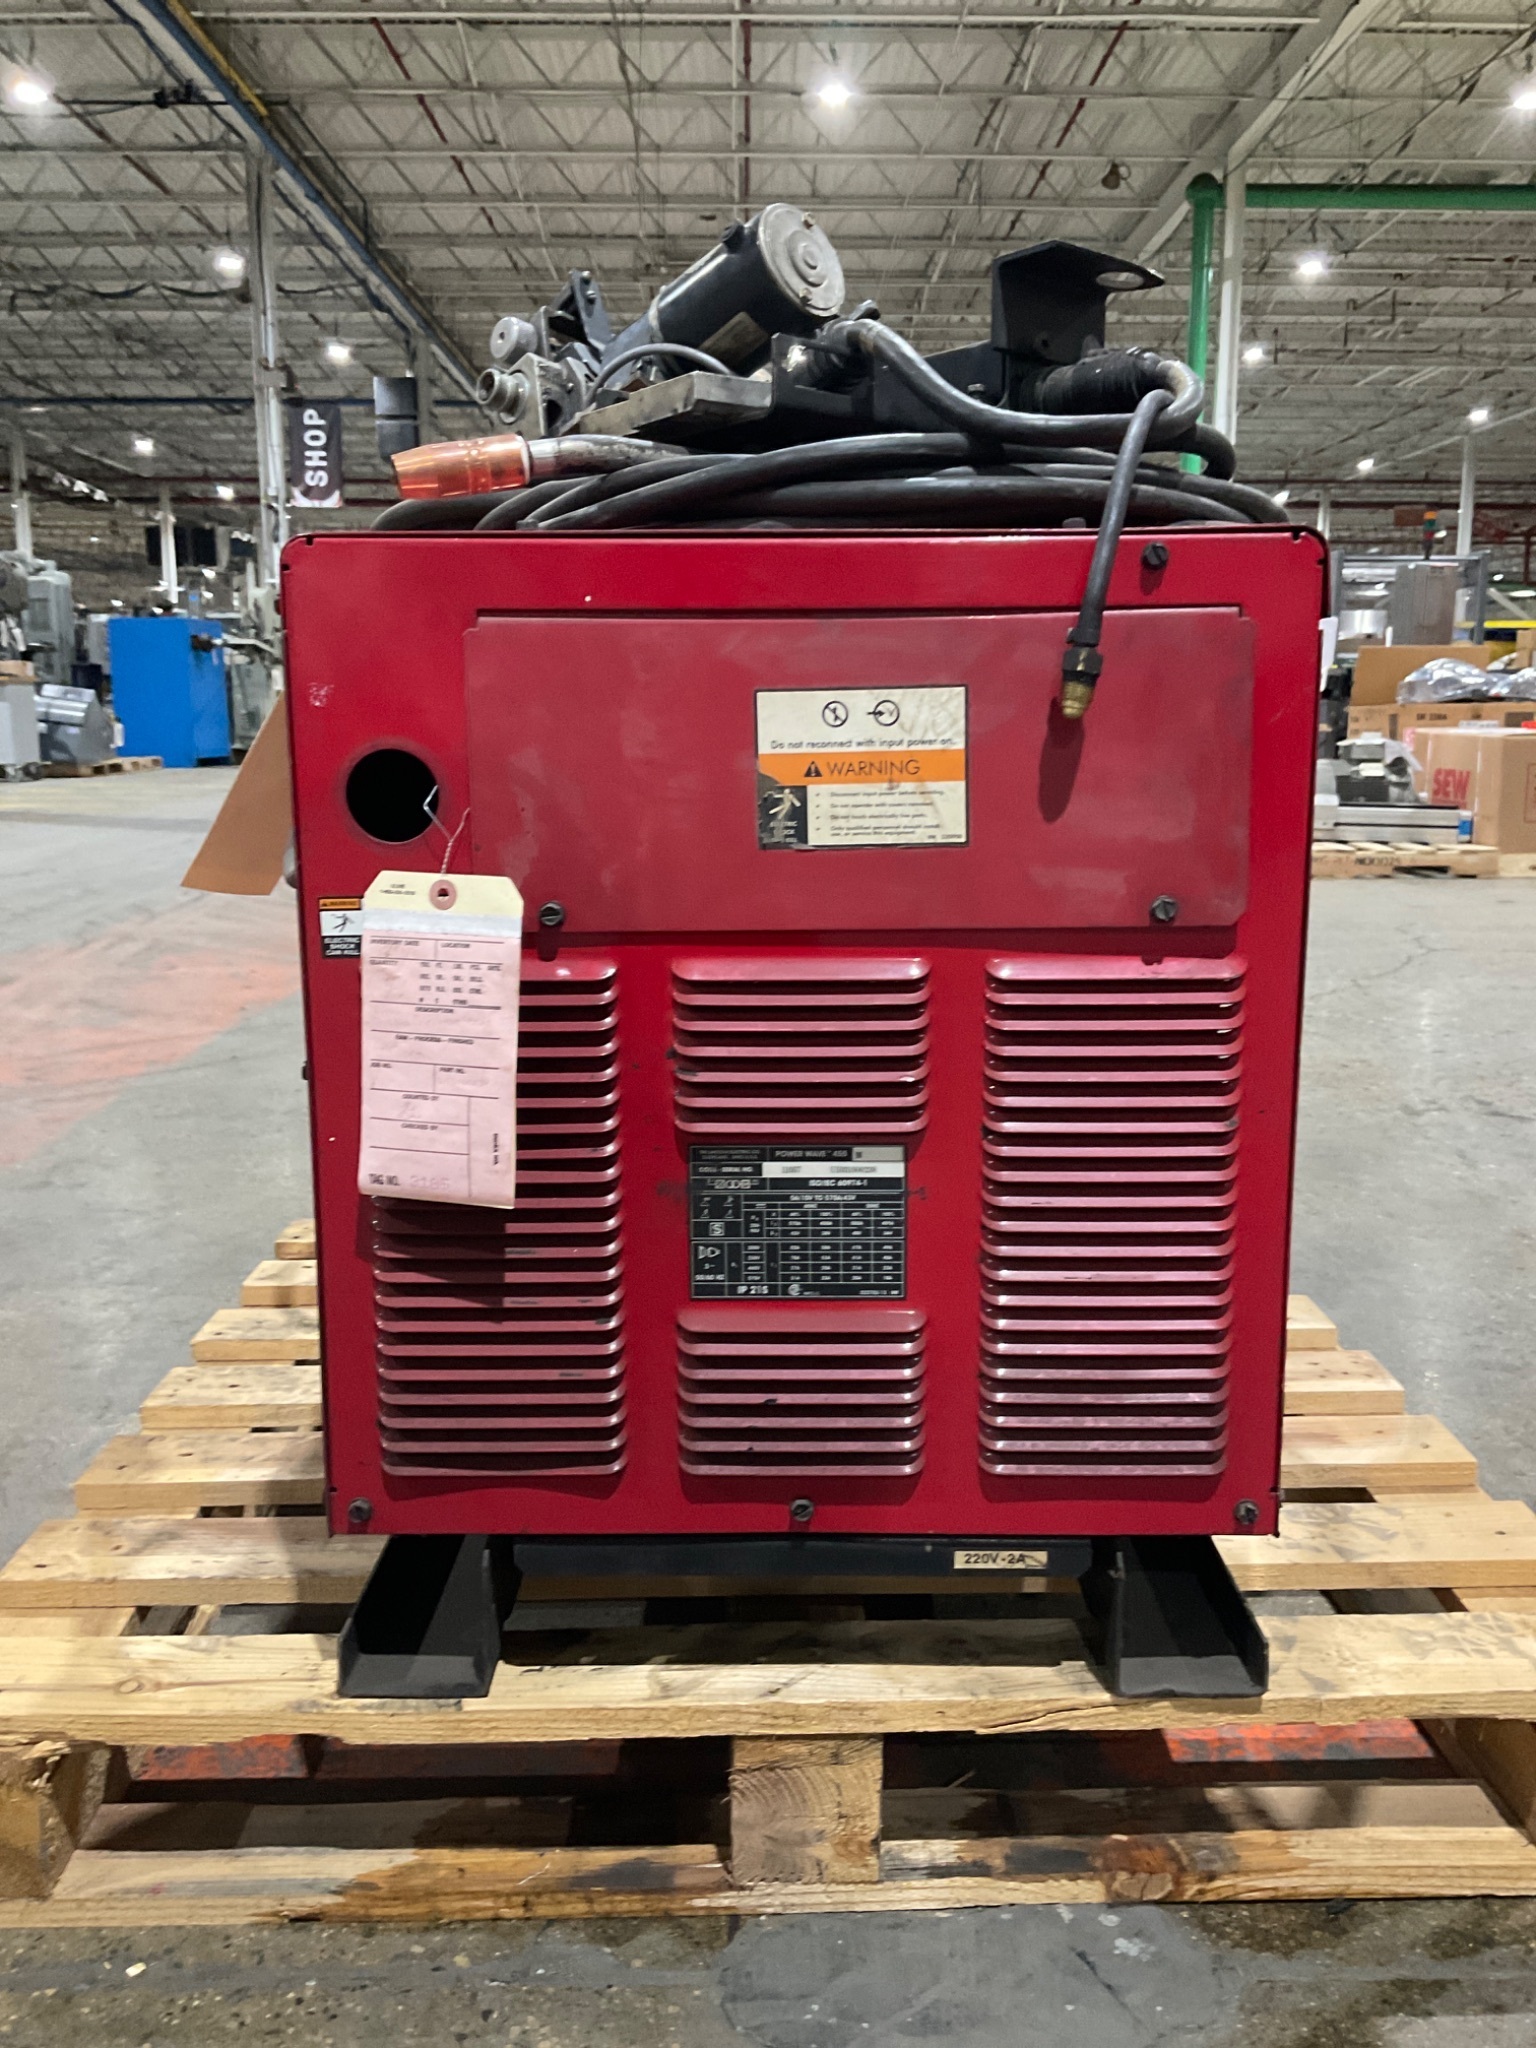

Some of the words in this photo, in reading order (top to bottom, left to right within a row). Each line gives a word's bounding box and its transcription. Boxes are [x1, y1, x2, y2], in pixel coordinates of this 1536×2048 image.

[303, 409, 329, 487] SHOP
[827, 759, 920, 777] WARNING
[1433, 768, 1471, 799] SEW
